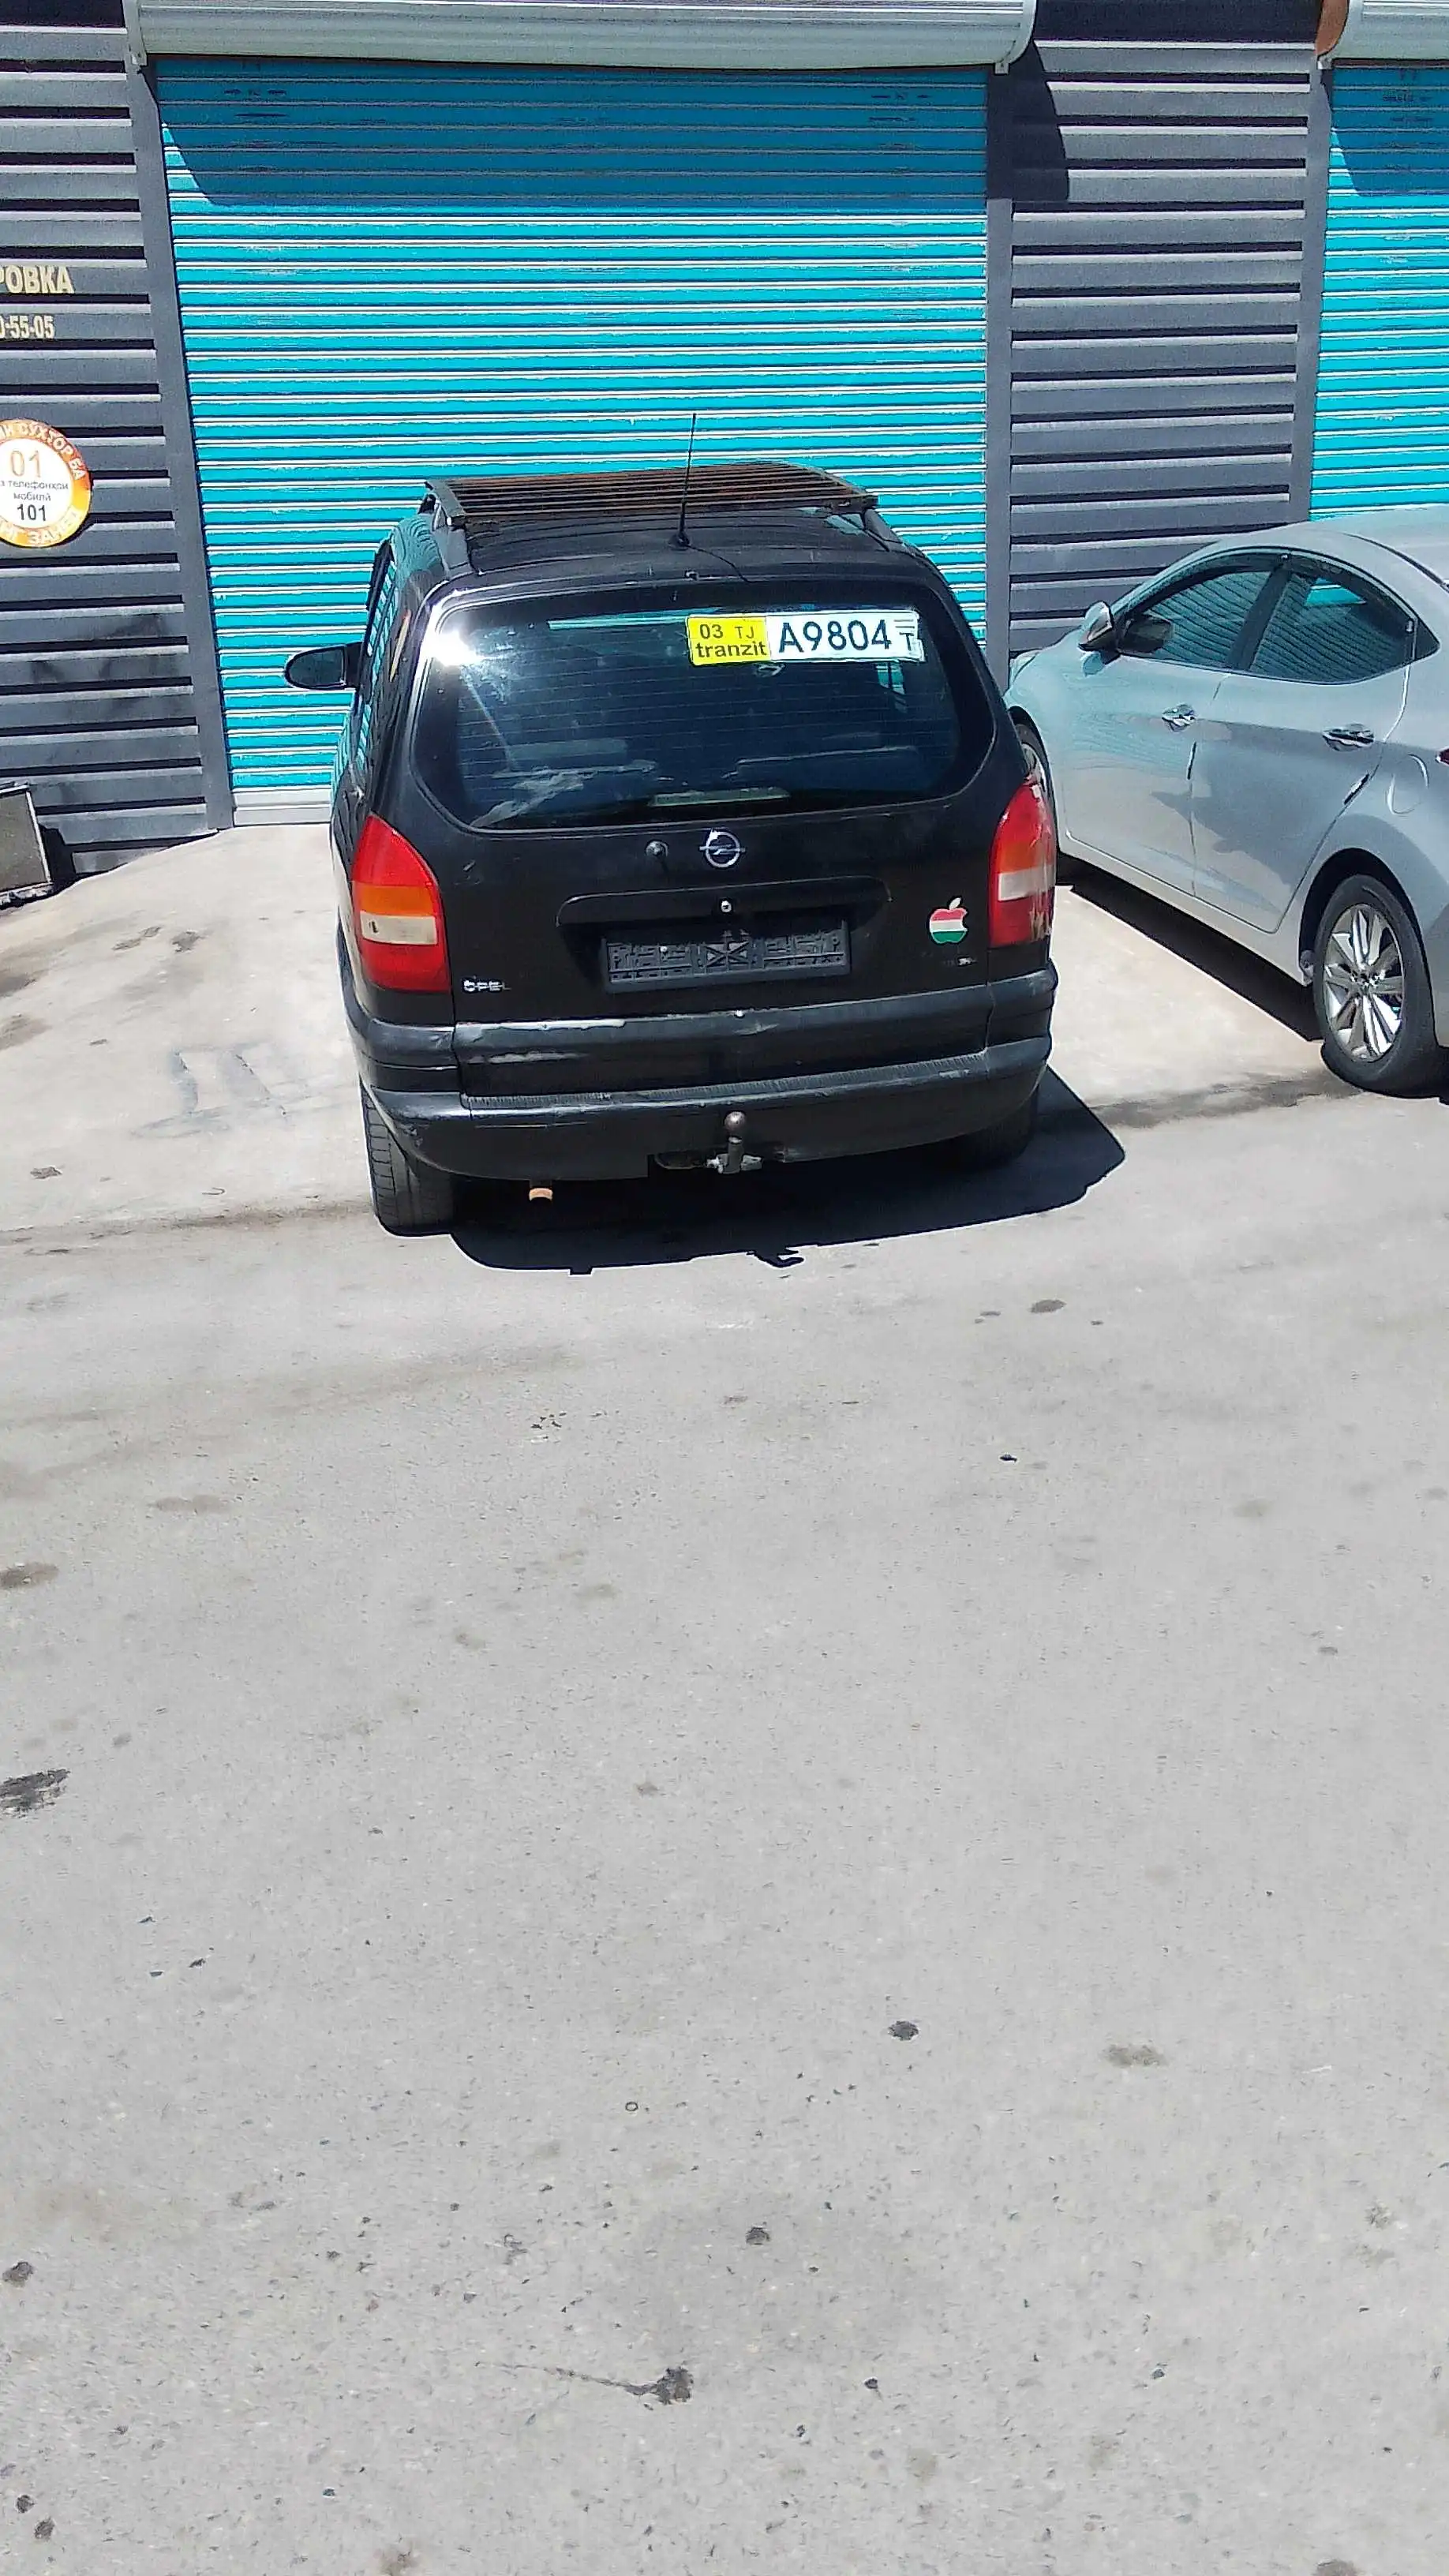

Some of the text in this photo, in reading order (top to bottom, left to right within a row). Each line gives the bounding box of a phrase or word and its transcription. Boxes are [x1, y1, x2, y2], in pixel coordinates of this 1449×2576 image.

[0, 265, 75, 294] ОВКА
[10, 450, 41, 477] 01
[17, 504, 46, 521] 101
[699, 623, 754, 639] 03 TJ
[778, 619, 892, 653] A9804
[695, 641, 767, 657] tranzit
